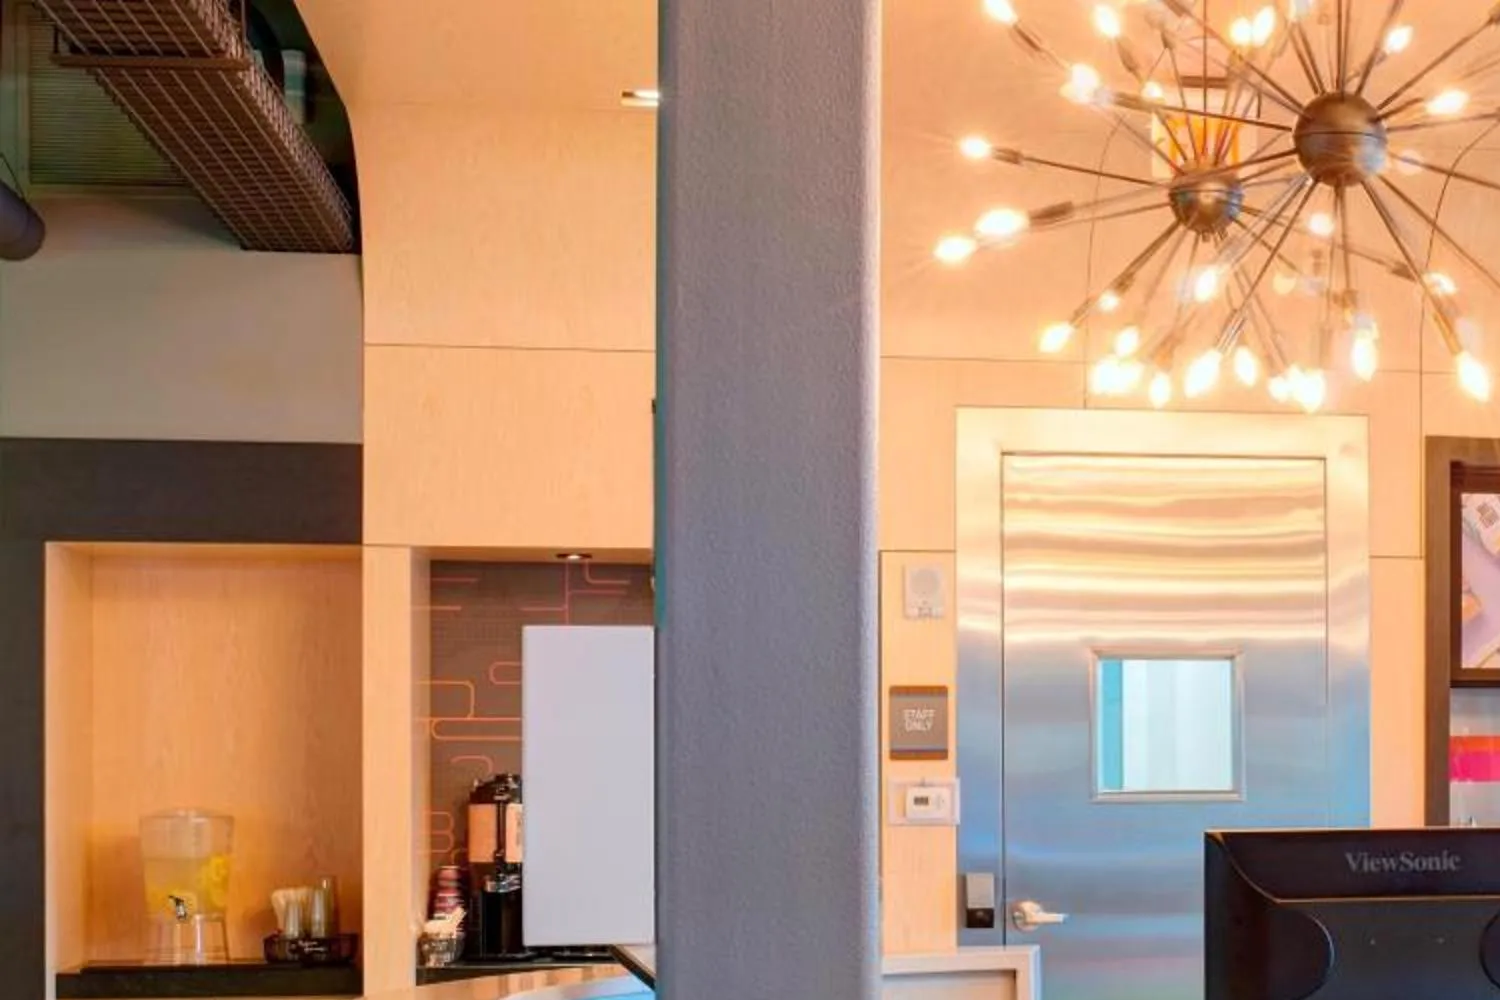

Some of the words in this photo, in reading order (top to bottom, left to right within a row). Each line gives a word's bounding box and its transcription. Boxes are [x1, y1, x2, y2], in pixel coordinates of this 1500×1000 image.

[904, 708, 936, 720] STAFF
[905, 719, 933, 732] ONLY
[1345, 850, 1460, 872] ViewSonic
